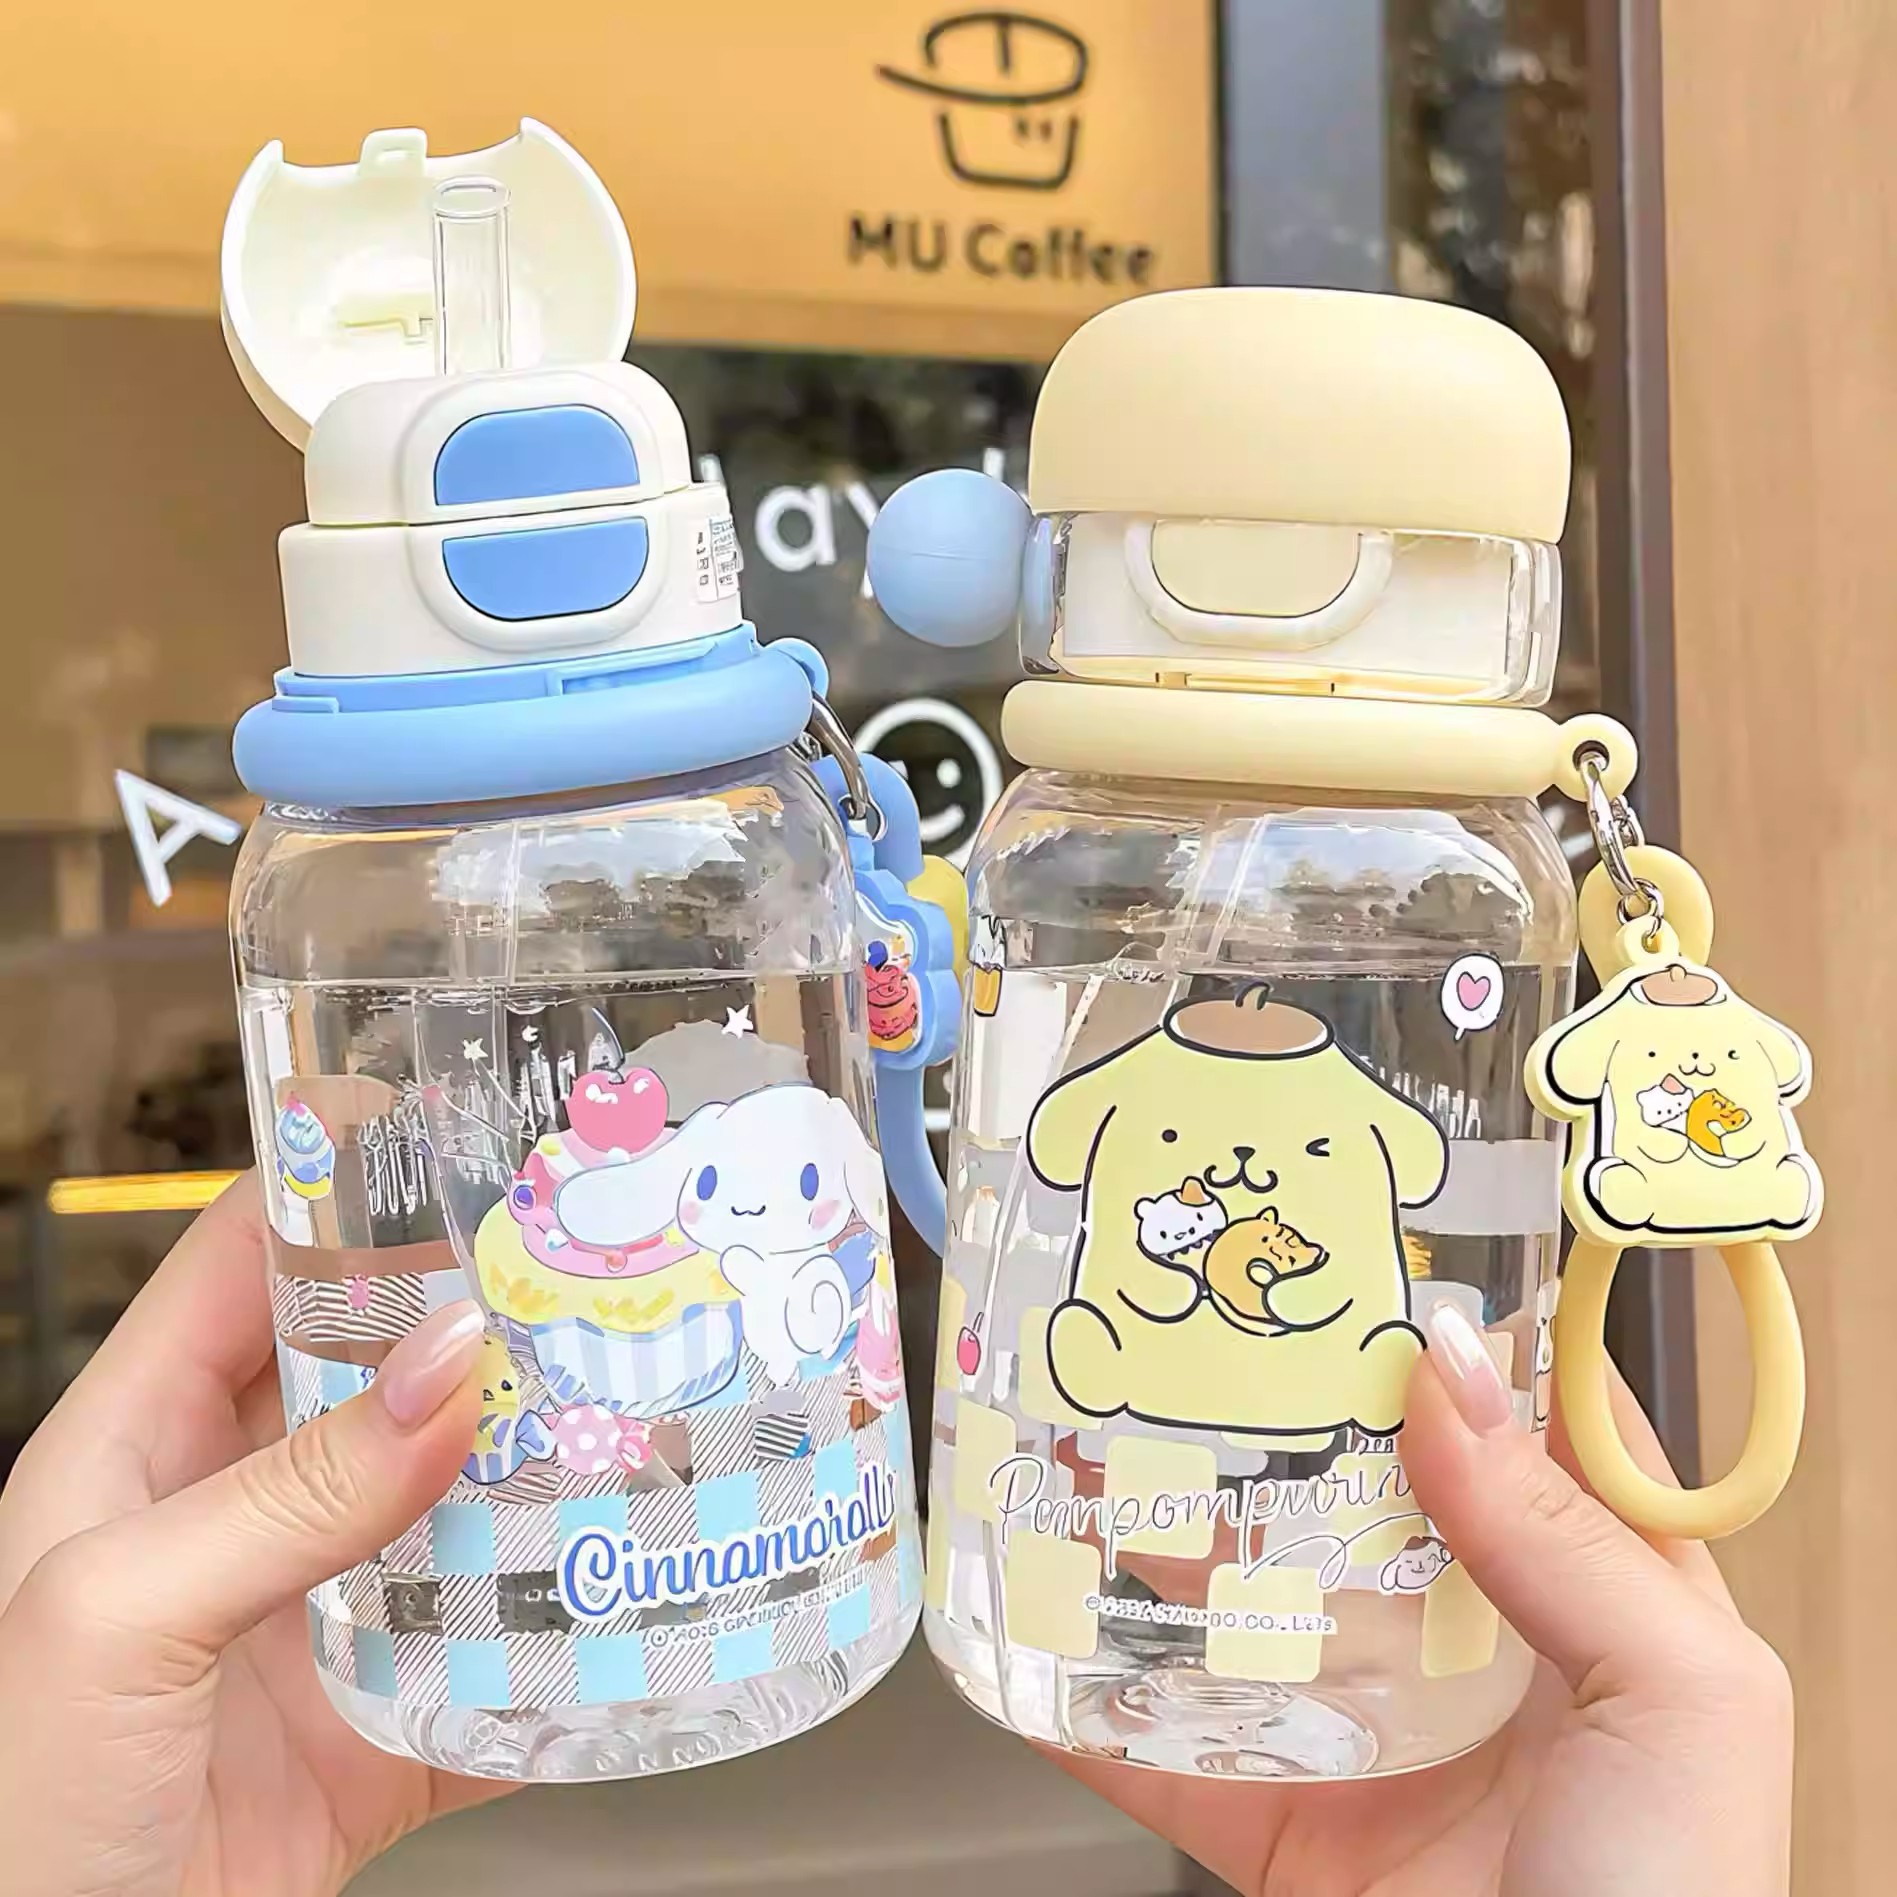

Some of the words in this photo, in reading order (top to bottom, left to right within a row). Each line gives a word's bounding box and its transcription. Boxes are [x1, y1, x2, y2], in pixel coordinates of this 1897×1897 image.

[848, 214, 948, 271] MU
[965, 222, 1155, 285] Coffee
[562, 1462, 896, 1617] Cinnamoroll
